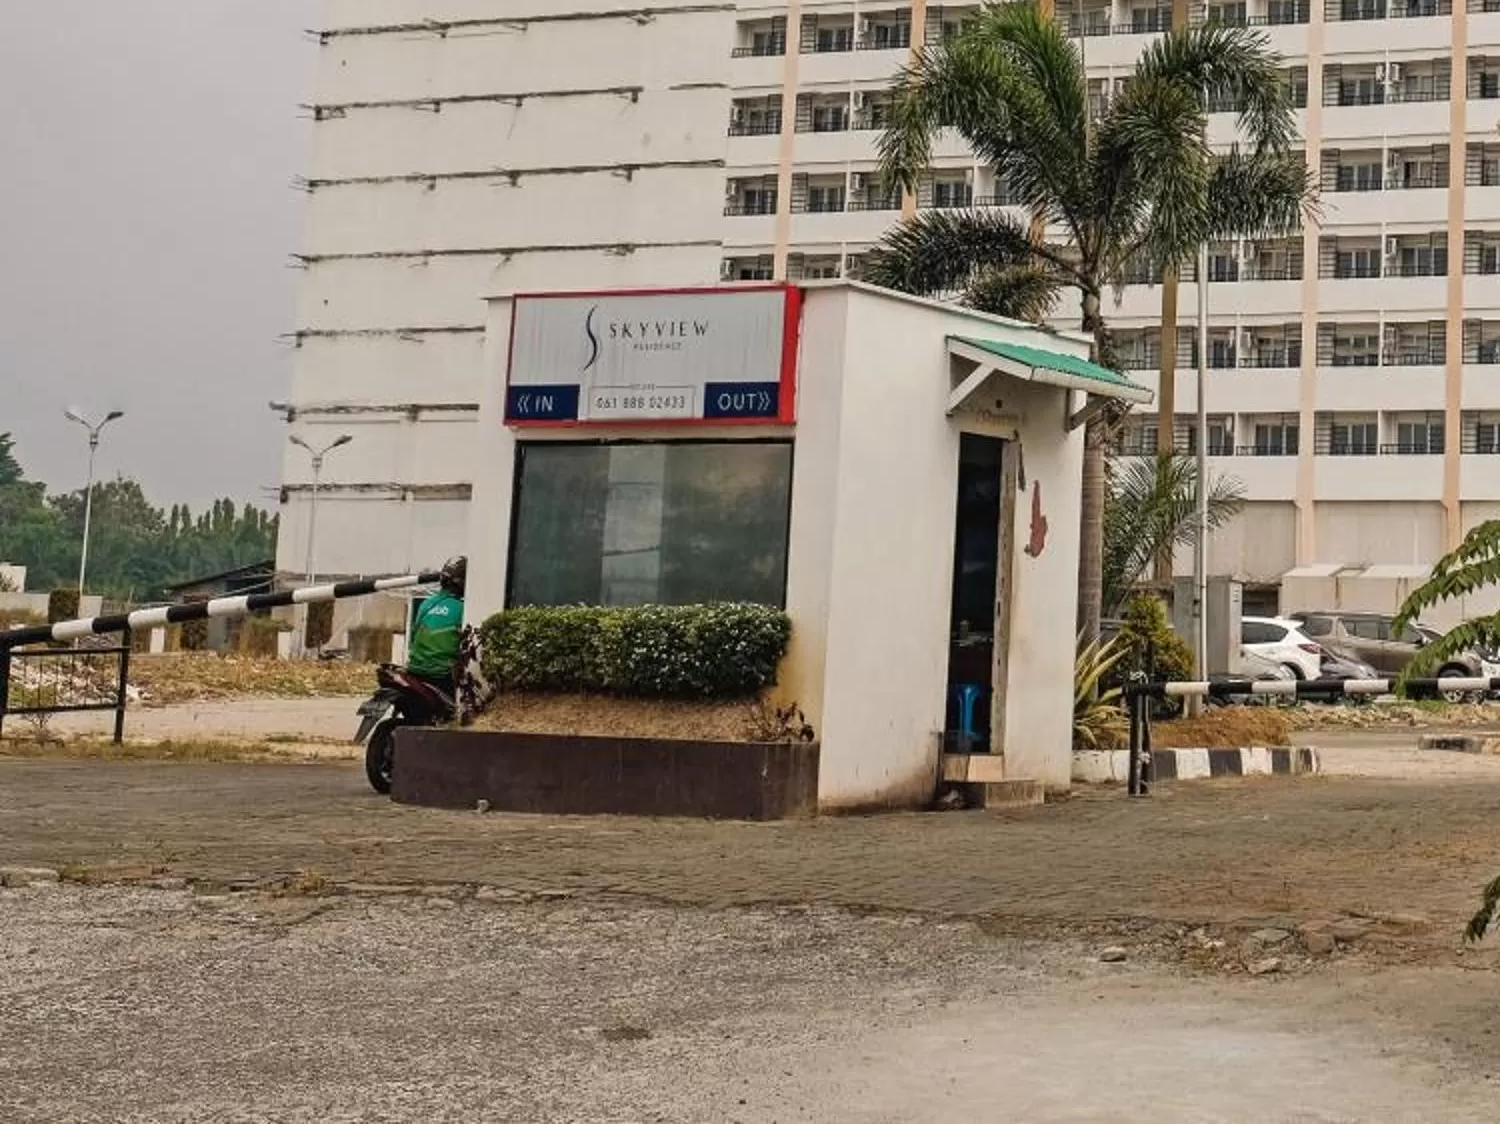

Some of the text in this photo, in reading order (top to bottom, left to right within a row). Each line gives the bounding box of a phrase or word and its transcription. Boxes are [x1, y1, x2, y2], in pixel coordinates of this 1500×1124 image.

[609, 321, 710, 338] SKYVIEW
[535, 394, 553, 411] IN
[717, 393, 756, 411] OUT
